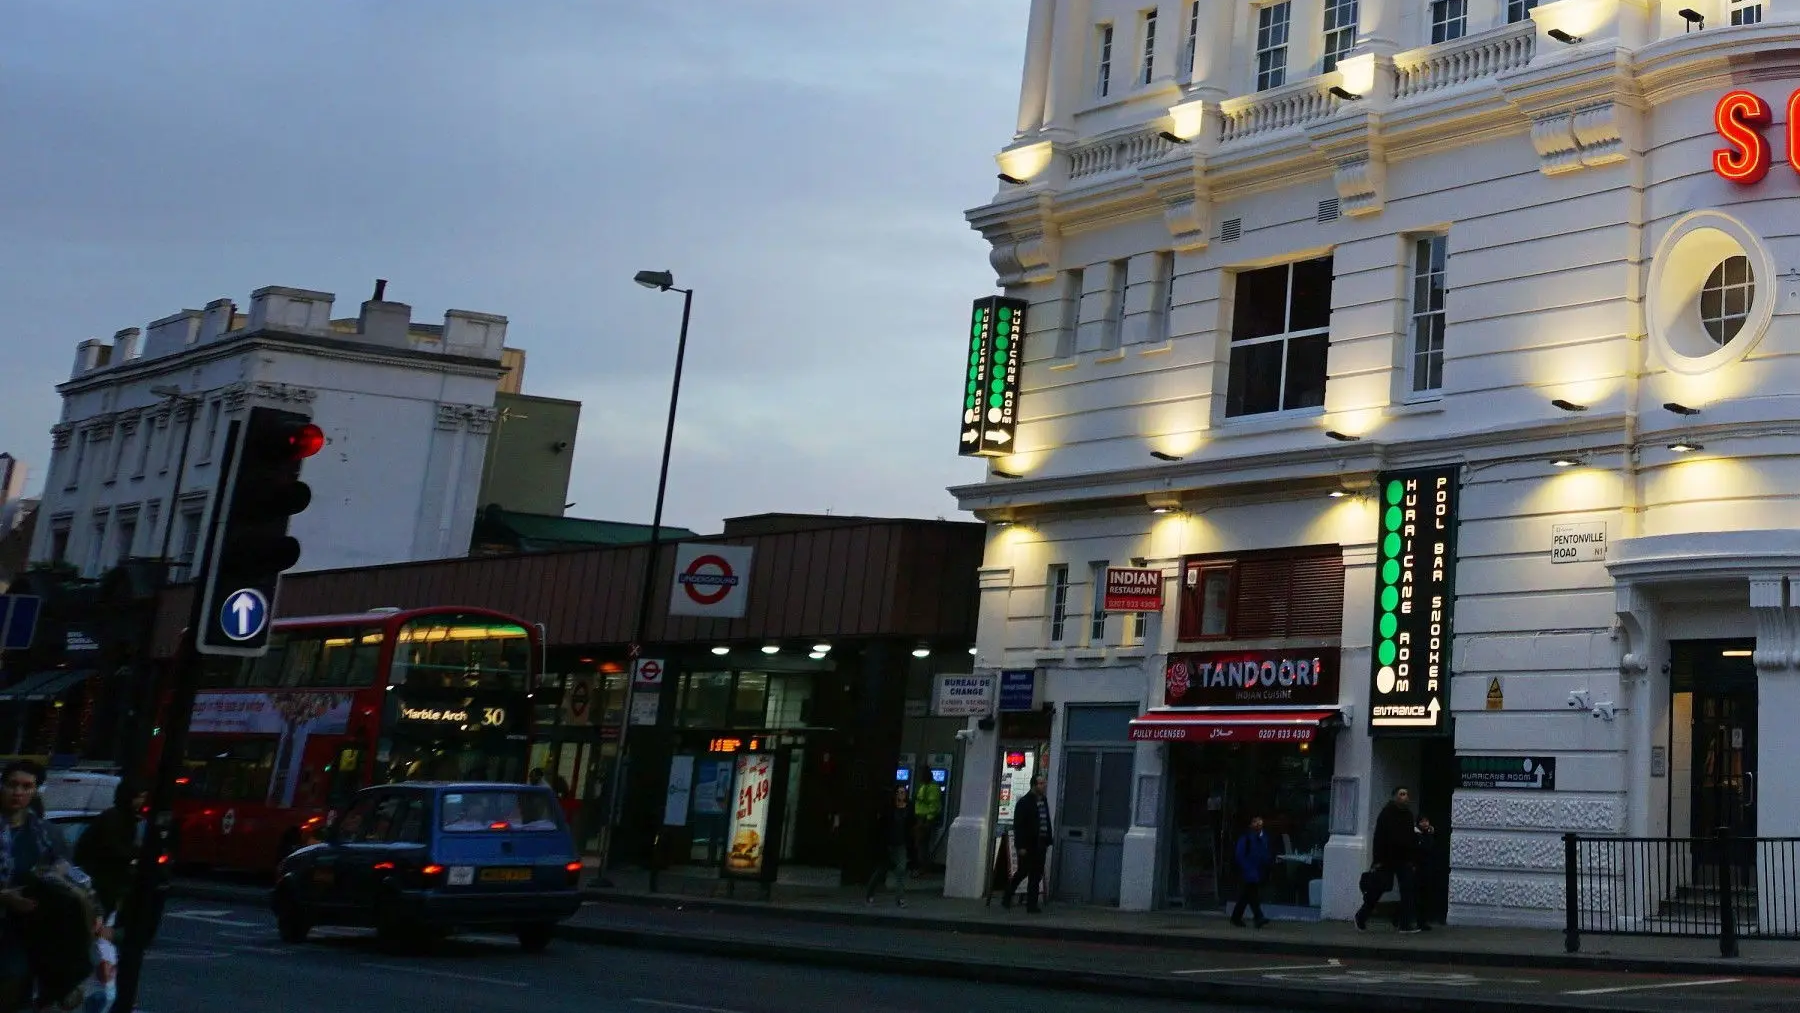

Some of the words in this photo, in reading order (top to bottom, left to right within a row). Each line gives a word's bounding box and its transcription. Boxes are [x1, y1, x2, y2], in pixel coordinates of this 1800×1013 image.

[978, 307, 990, 381] HURRICANE
[1007, 309, 1021, 383] HURRICANE
[972, 390, 983, 422] ROOM
[1002, 391, 1014, 424] ROOM
[1435, 477, 1447, 529] POOL
[1401, 479, 1417, 614] HURRICANE
[1554, 533, 1604, 545] PENTONVILLE
[1553, 547, 1577, 558] ROAD
[1432, 542, 1444, 582] BAR
[1110, 571, 1158, 585] INDIAN
[1109, 586, 1157, 594] RESTAURANT
[1427, 596, 1442, 692] SNOOKER
[1396, 632, 1410, 692] ROOM
[1200, 657, 1321, 688] TANDOORI
[944, 678, 977, 687] BUREAU
[979, 678, 990, 687] DE
[950, 688, 984, 696] CHANGE
[1235, 691, 1262, 700] INDIAN
[1263, 689, 1292, 699] CUISINE
[402, 708, 441, 720] Marble
[441, 709, 469, 721] Arch
[481, 707, 505, 726] 30
[1373, 705, 1425, 716] ENTRANCE
[1133, 729, 1152, 738] FULLY
[1154, 729, 1186, 738] LICENSED
[1258, 729, 1276, 739] 0207
[1277, 729, 1291, 739] 833
[1292, 729, 1310, 739] 4308
[1461, 772, 1505, 781] HURRICANE
[1507, 773, 1531, 781] ROOM
